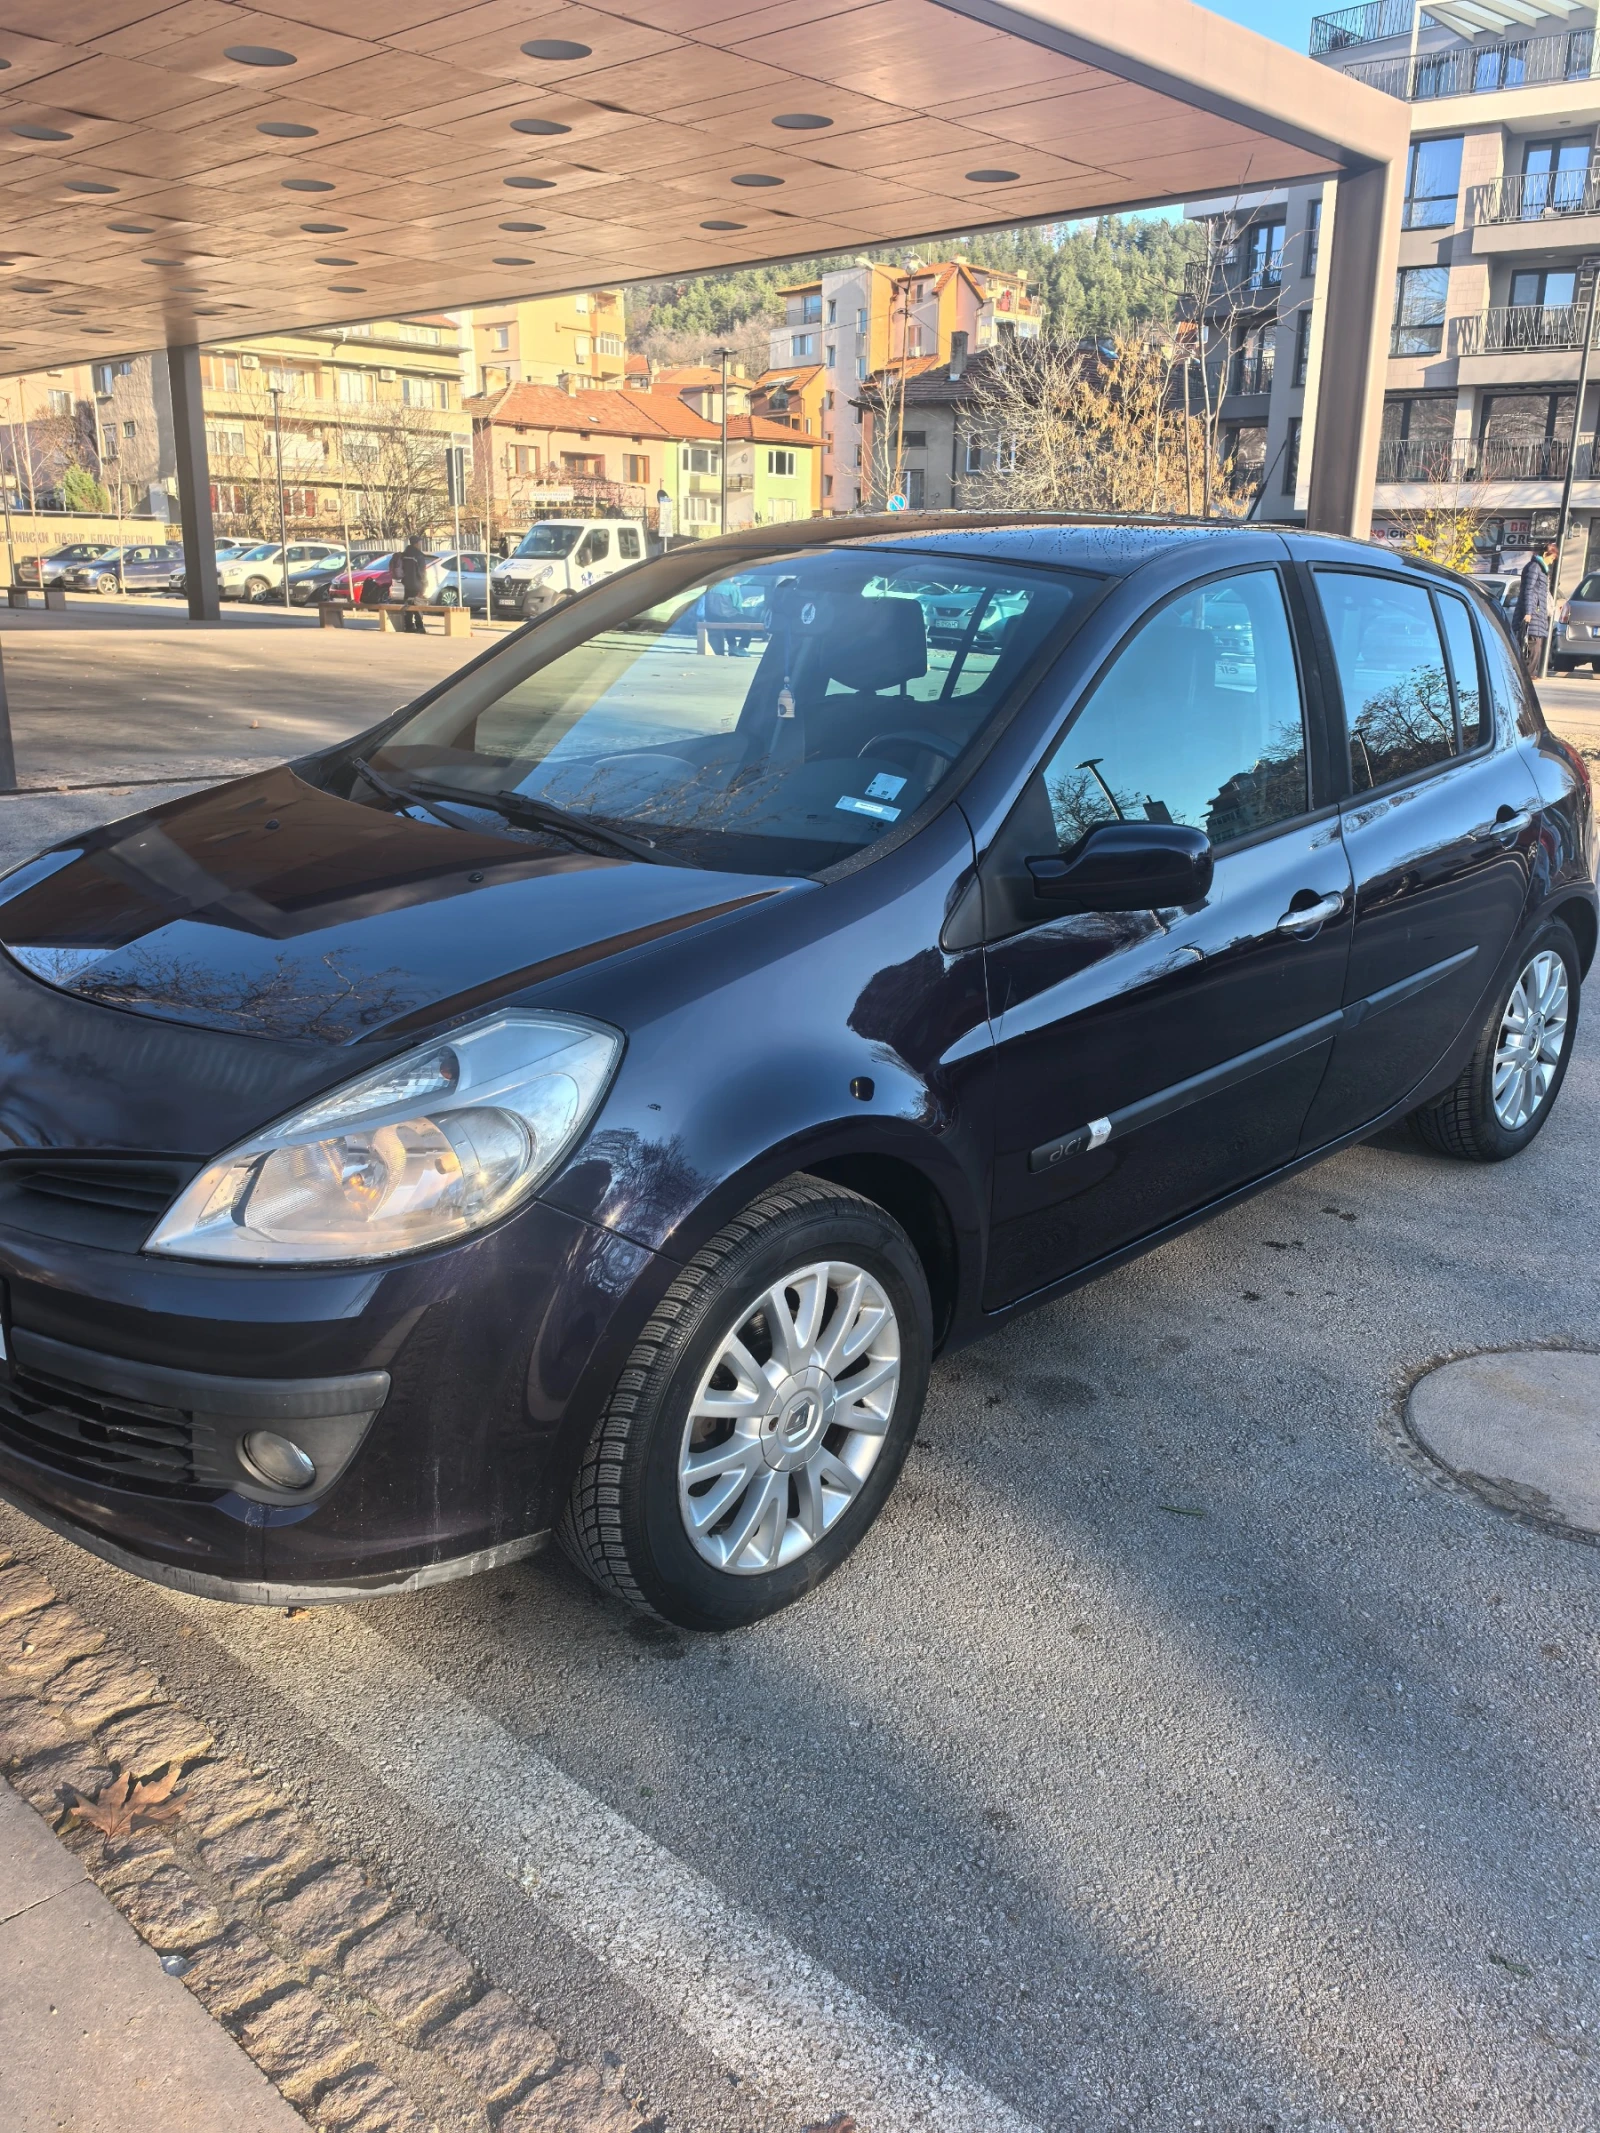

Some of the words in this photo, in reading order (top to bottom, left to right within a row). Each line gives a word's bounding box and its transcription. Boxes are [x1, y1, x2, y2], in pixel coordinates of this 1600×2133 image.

[0, 531, 49, 544] БЩИНСКИ
[54, 532, 85, 544] ПАЗАР
[1050, 1137, 1081, 1162] dCi
